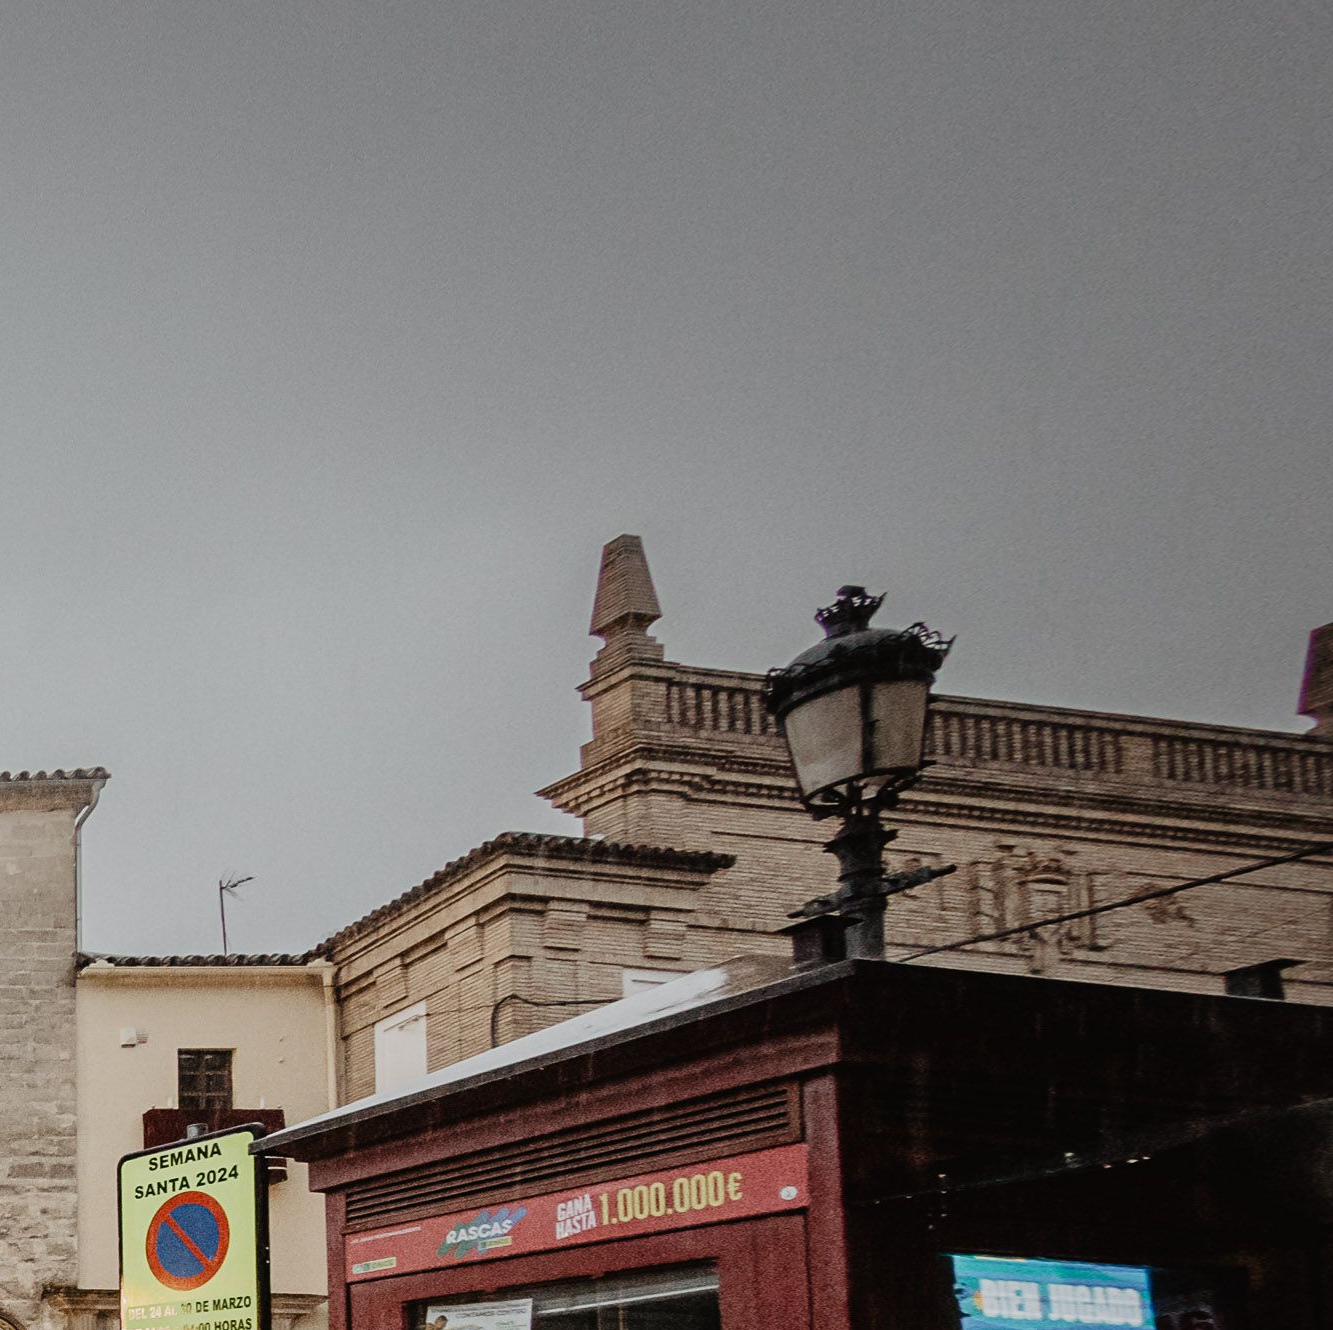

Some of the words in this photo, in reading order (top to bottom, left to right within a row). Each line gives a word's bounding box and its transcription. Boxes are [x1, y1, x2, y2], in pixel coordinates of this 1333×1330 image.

[148, 1142, 222, 1171] SEMANA
[134, 1175, 190, 1199] SANTA
[196, 1164, 239, 1188] 2024
[557, 1193, 592, 1222] GANA
[599, 1170, 743, 1226] 1.000.000€
[445, 1218, 514, 1245] RASCAS
[555, 1210, 597, 1240] HASTA
[129, 1307, 147, 1320] DEL
[196, 1300, 209, 1313] DE
[213, 1296, 252, 1311] MARZO
